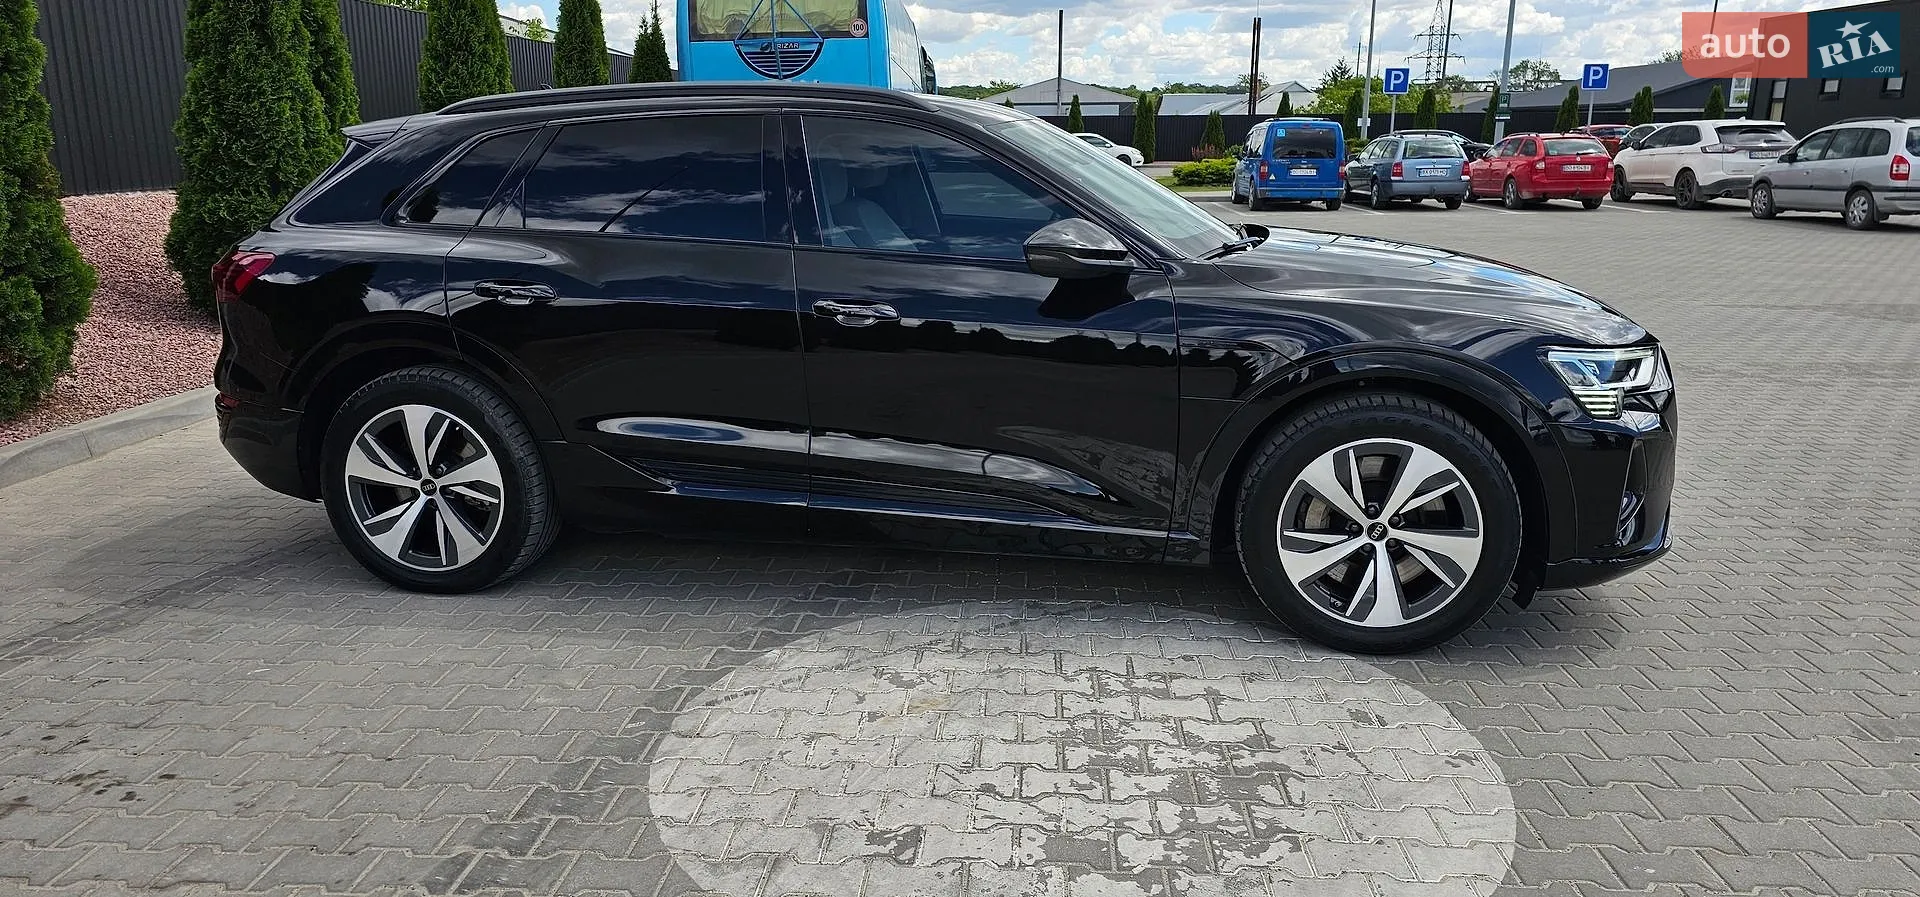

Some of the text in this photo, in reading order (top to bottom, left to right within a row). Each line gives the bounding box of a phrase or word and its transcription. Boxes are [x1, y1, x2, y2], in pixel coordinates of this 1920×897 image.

[853, 23, 865, 32] 100
[1390, 70, 1405, 91] P
[1589, 66, 1604, 87] P
